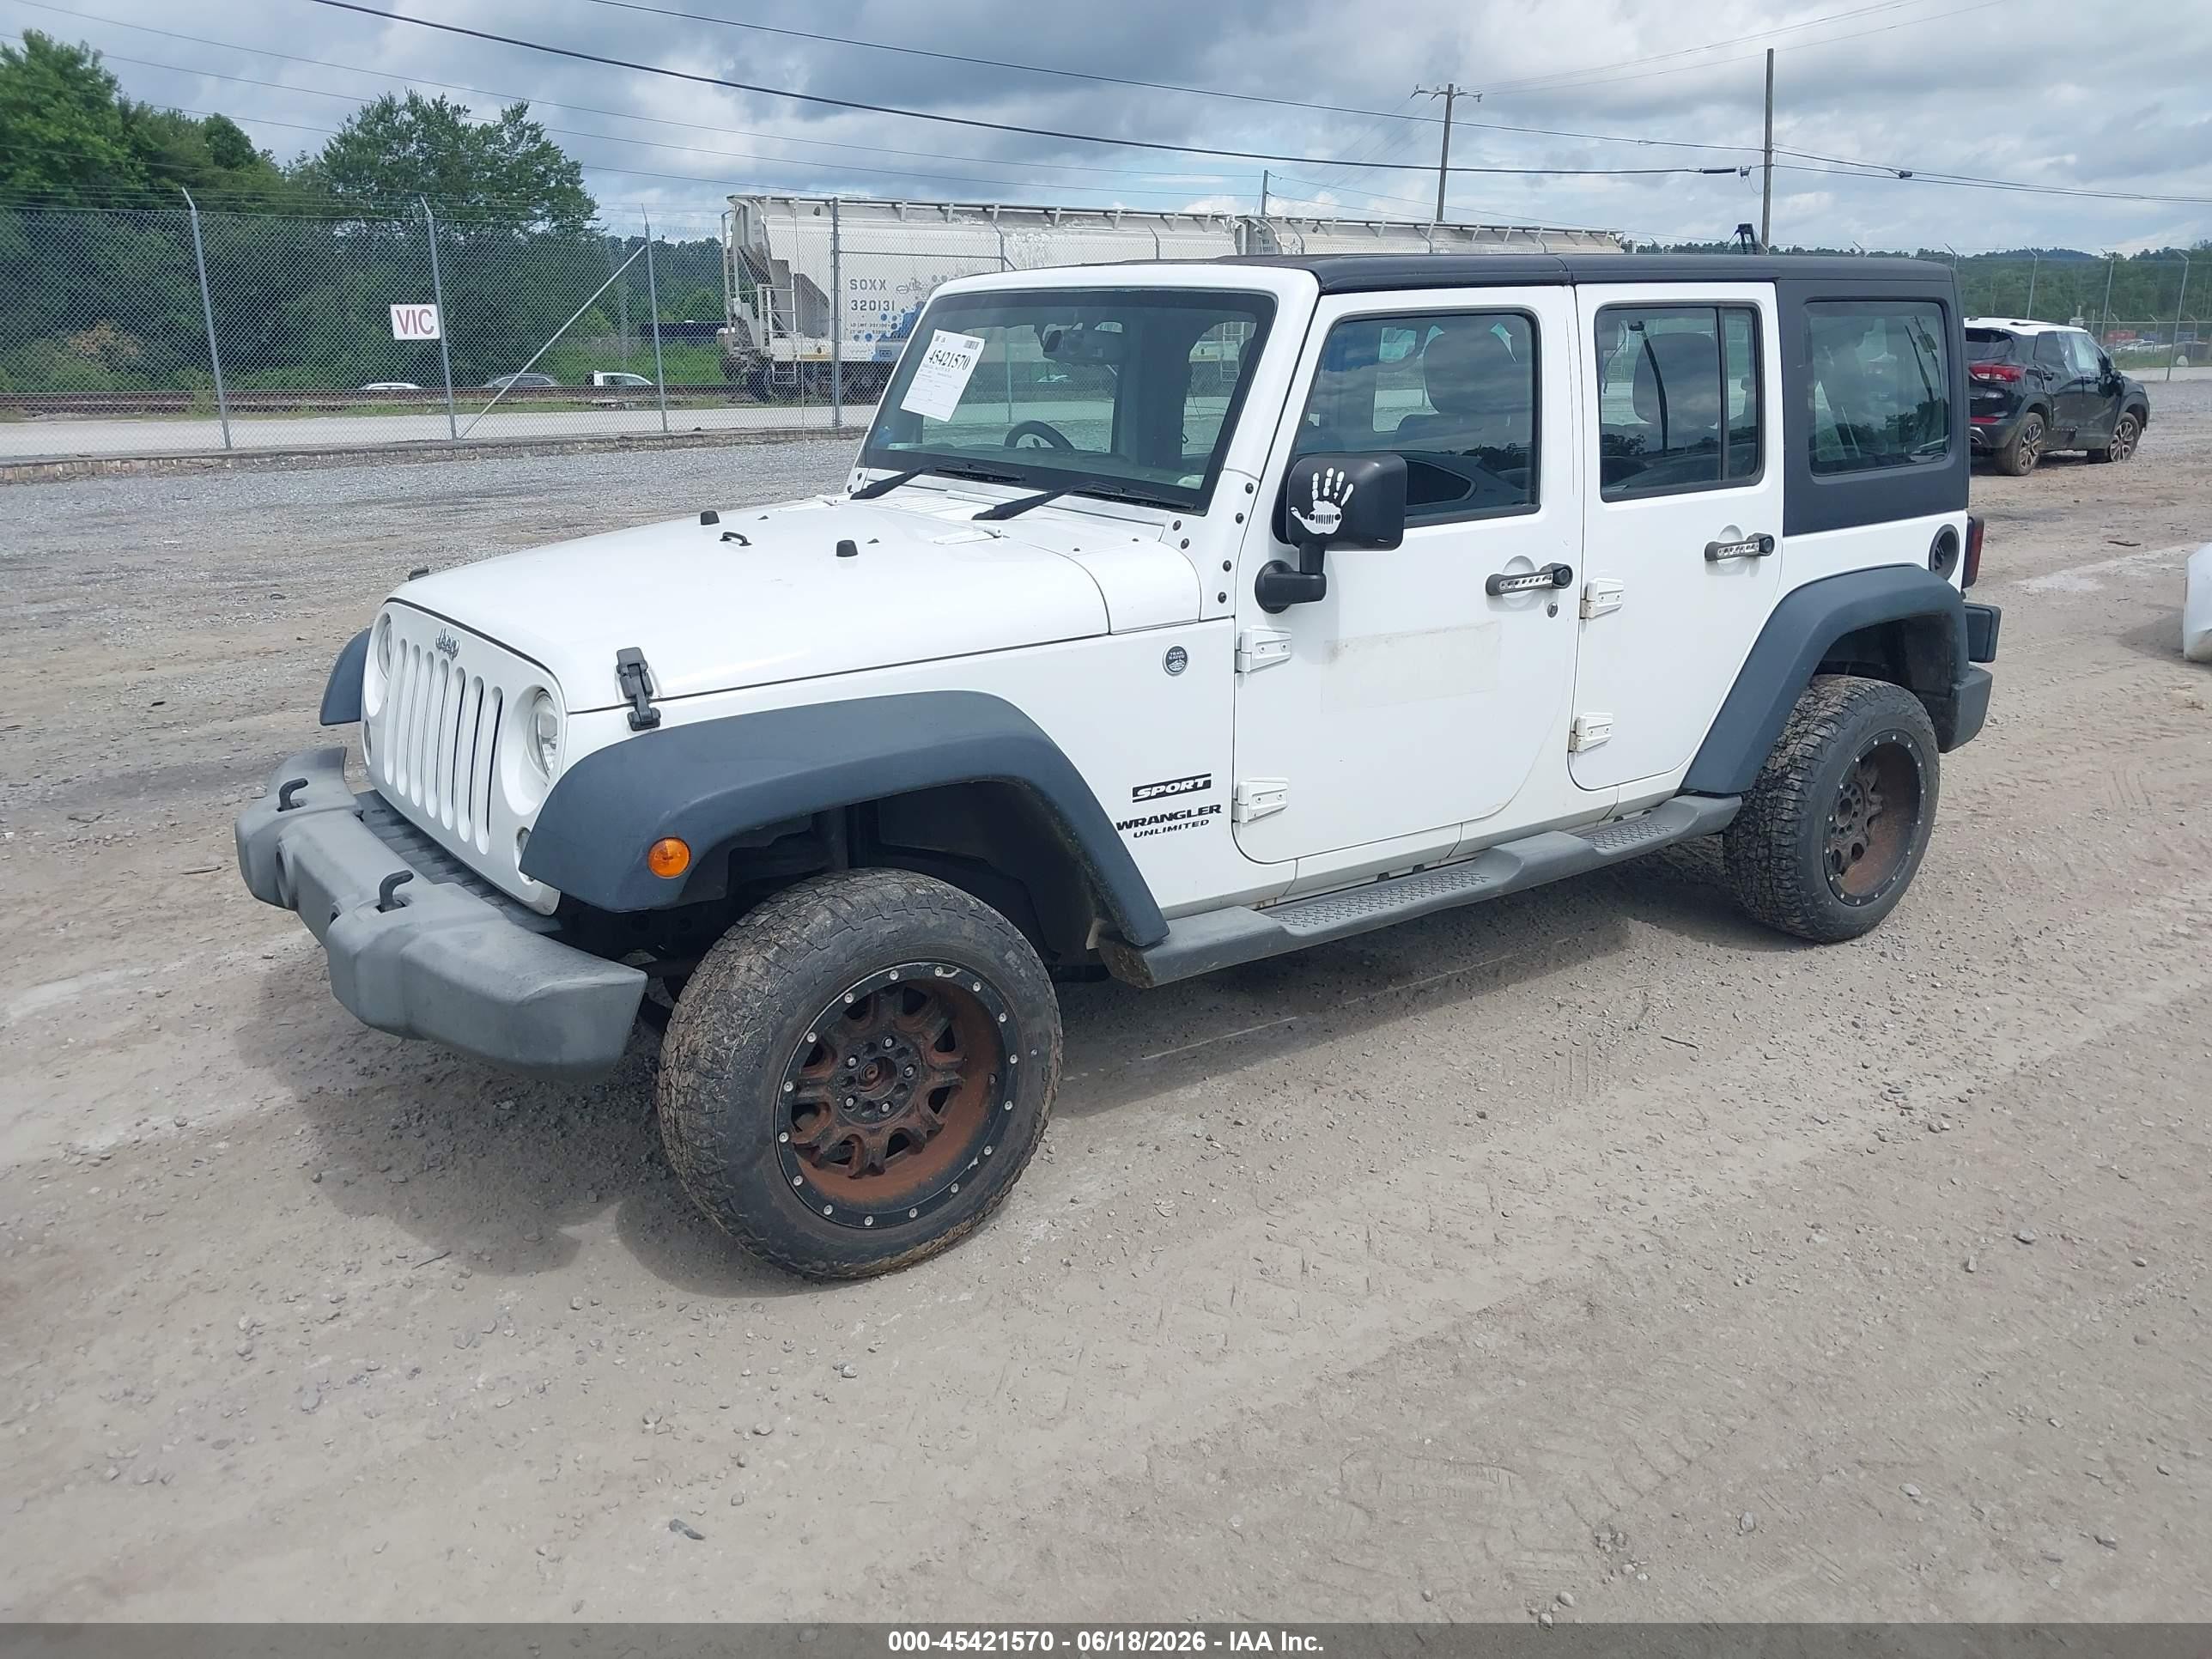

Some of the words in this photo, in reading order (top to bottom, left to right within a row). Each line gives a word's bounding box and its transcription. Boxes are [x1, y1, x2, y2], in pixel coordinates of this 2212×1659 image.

[849, 278, 887, 291] SOXX
[851, 299, 895, 312] 320131
[395, 308, 434, 335] VIC
[928, 349, 971, 371] 45421570
[1133, 776, 1211, 799] SPORT
[1116, 804, 1223, 831] WRANGLER
[1133, 819, 1210, 838] UNLIMITED
